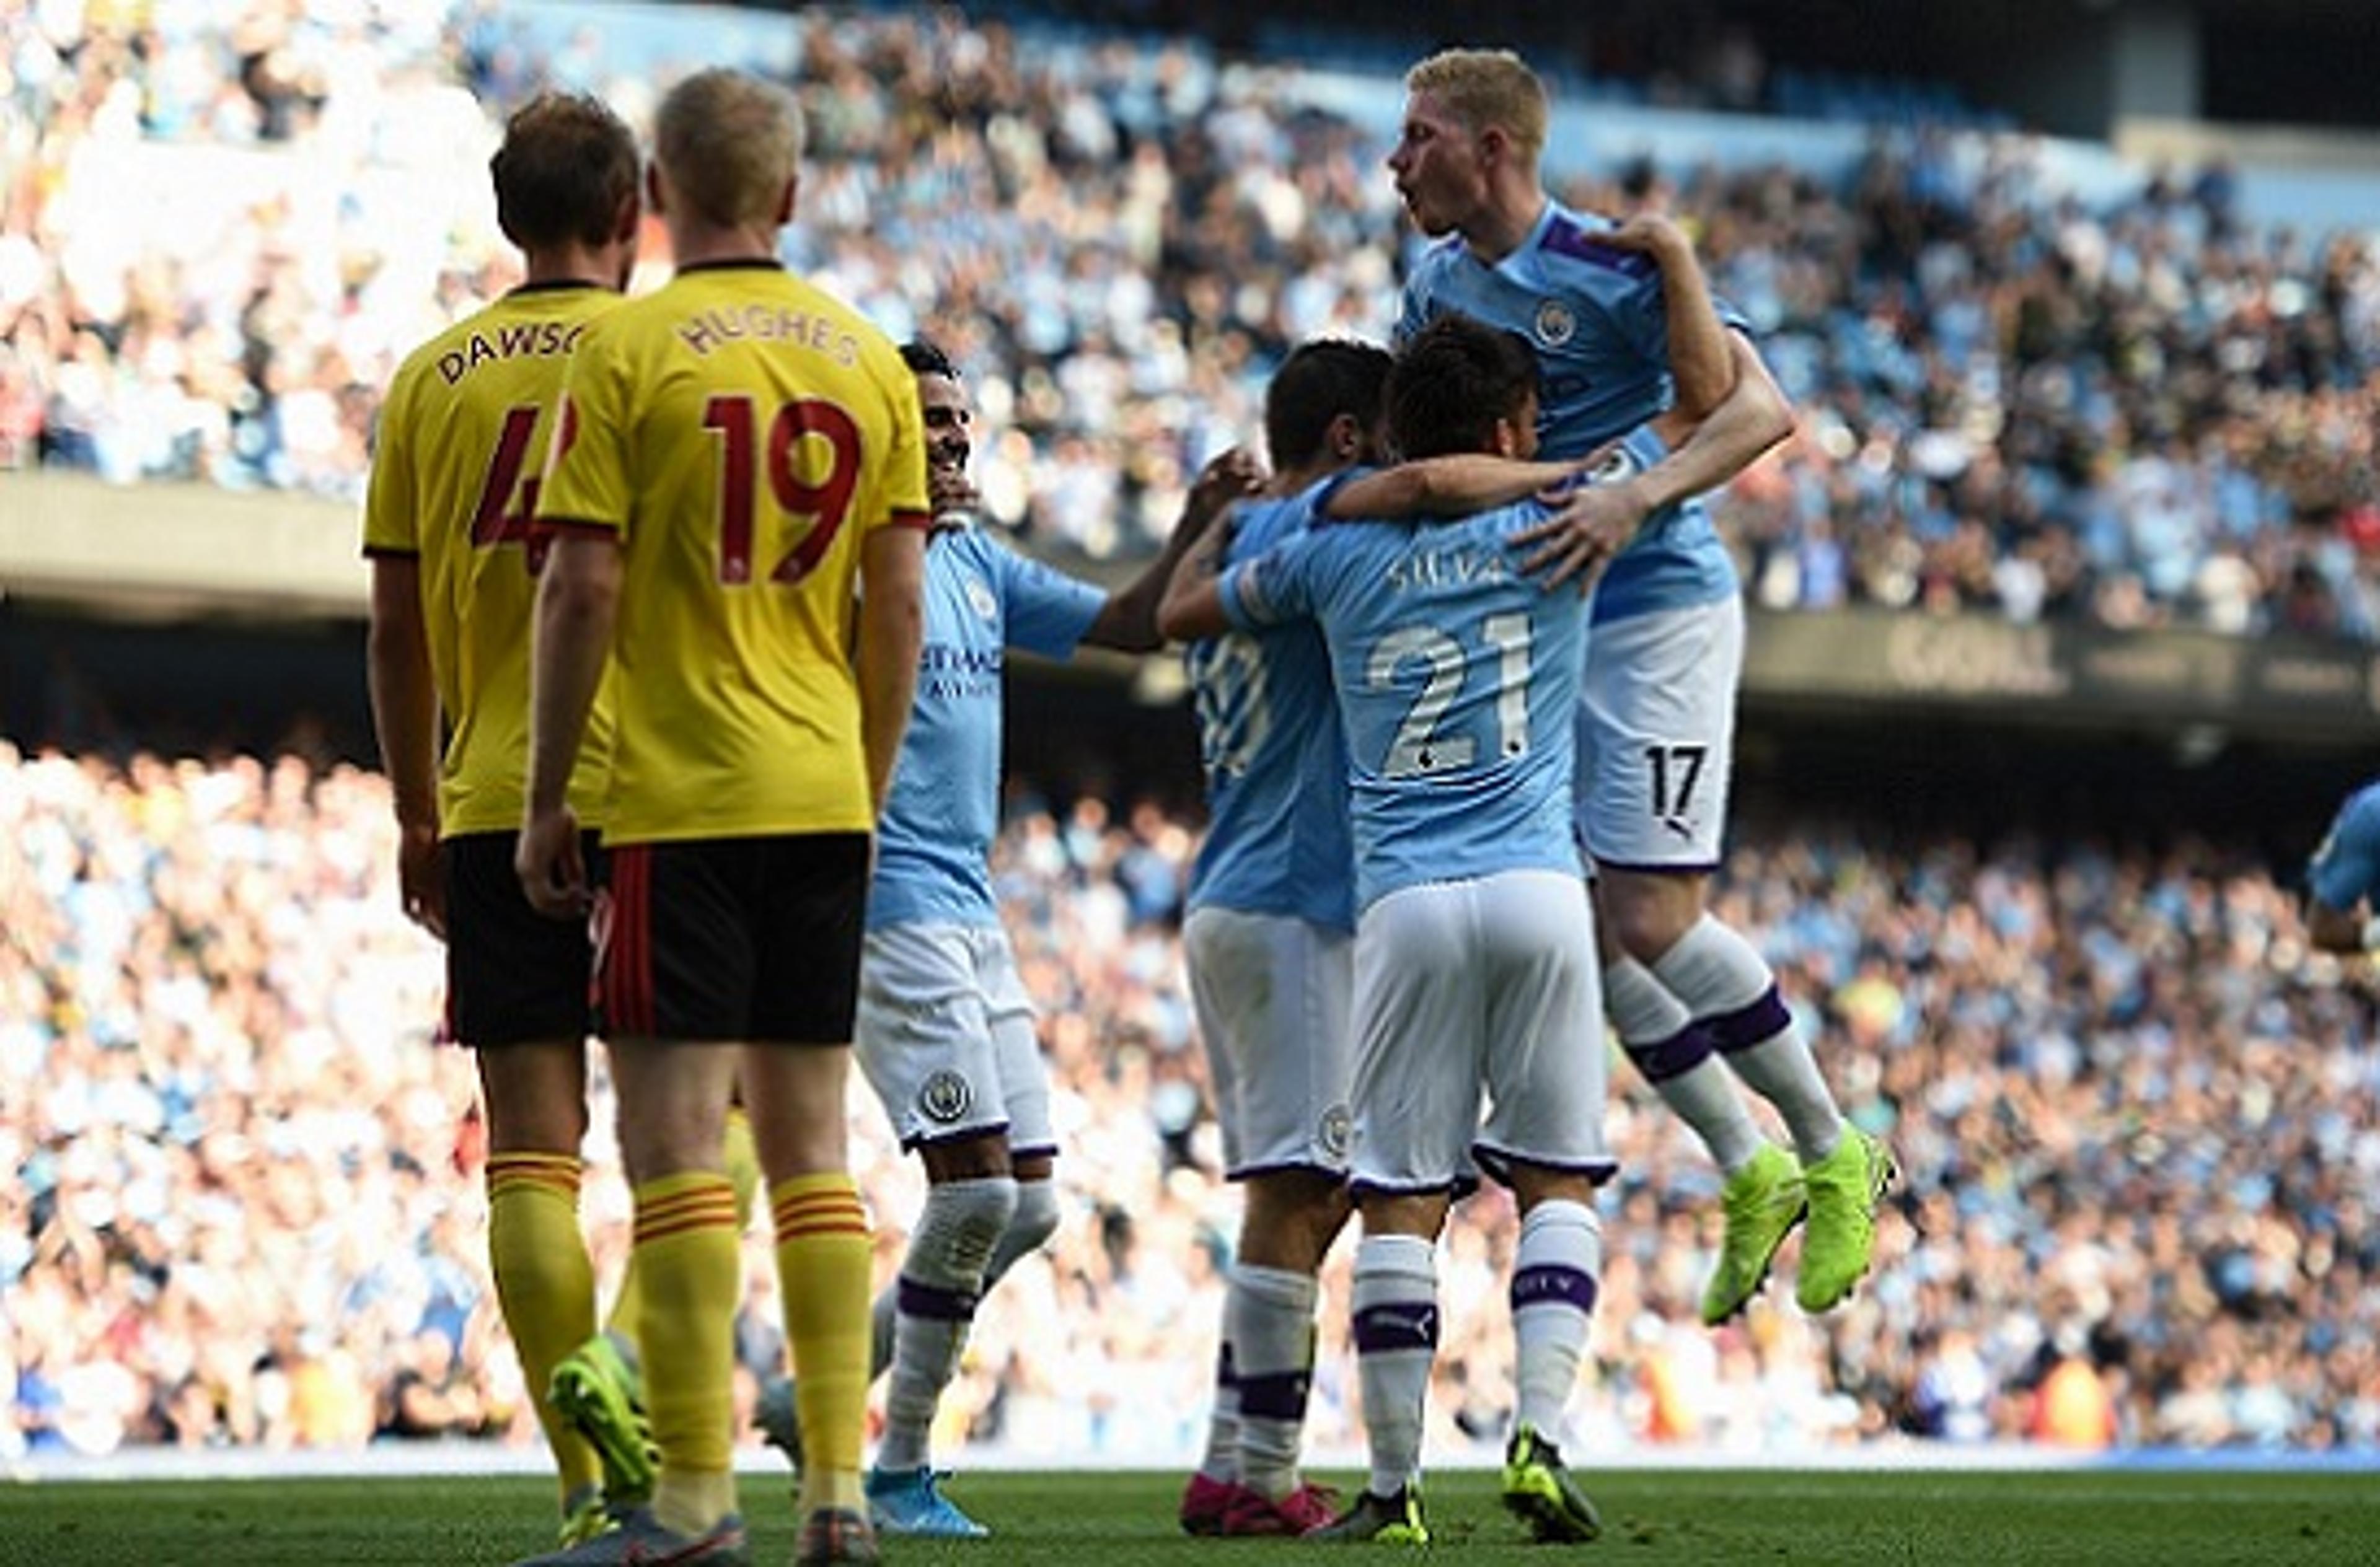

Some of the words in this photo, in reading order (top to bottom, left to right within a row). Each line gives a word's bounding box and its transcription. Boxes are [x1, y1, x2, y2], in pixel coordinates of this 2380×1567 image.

[680, 305, 859, 366] HUGHES
[469, 405, 553, 577] 4
[702, 395, 863, 585] 19
[1367, 613, 1533, 779] 21
[1646, 745, 1708, 817] 17
